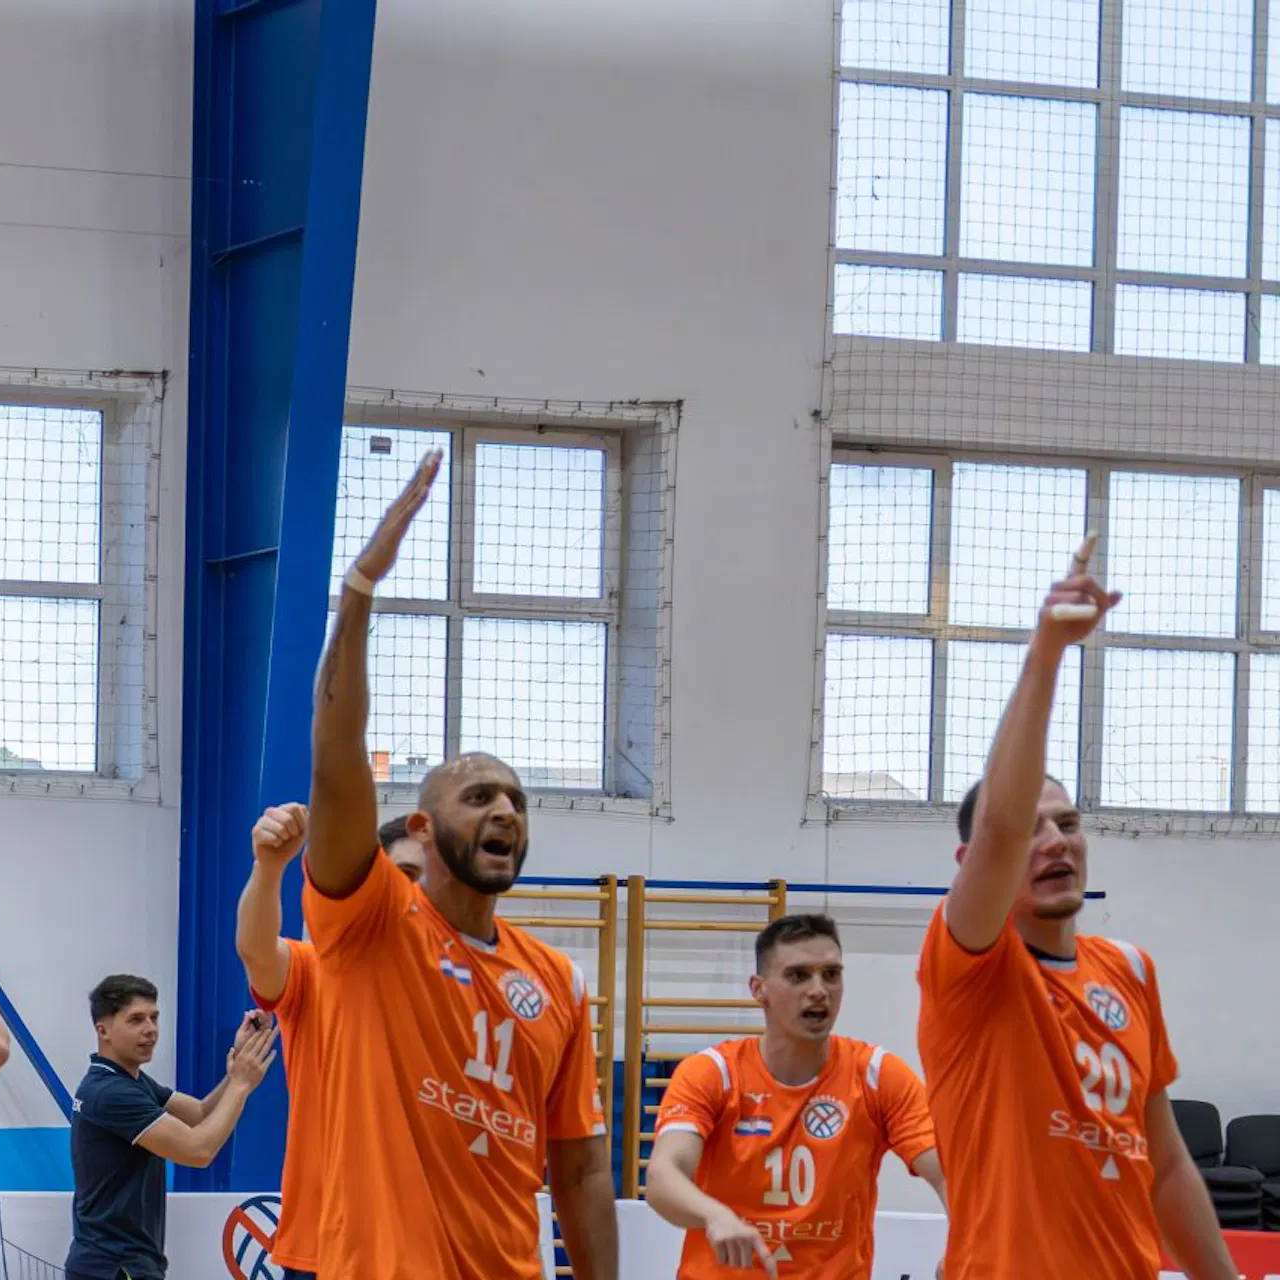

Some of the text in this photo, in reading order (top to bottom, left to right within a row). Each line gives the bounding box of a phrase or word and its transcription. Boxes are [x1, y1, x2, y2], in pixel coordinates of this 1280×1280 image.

[464, 1010, 516, 1092] 11
[1075, 1040, 1132, 1116] 20
[418, 1077, 537, 1144] statera
[763, 1145, 815, 1206] 10
